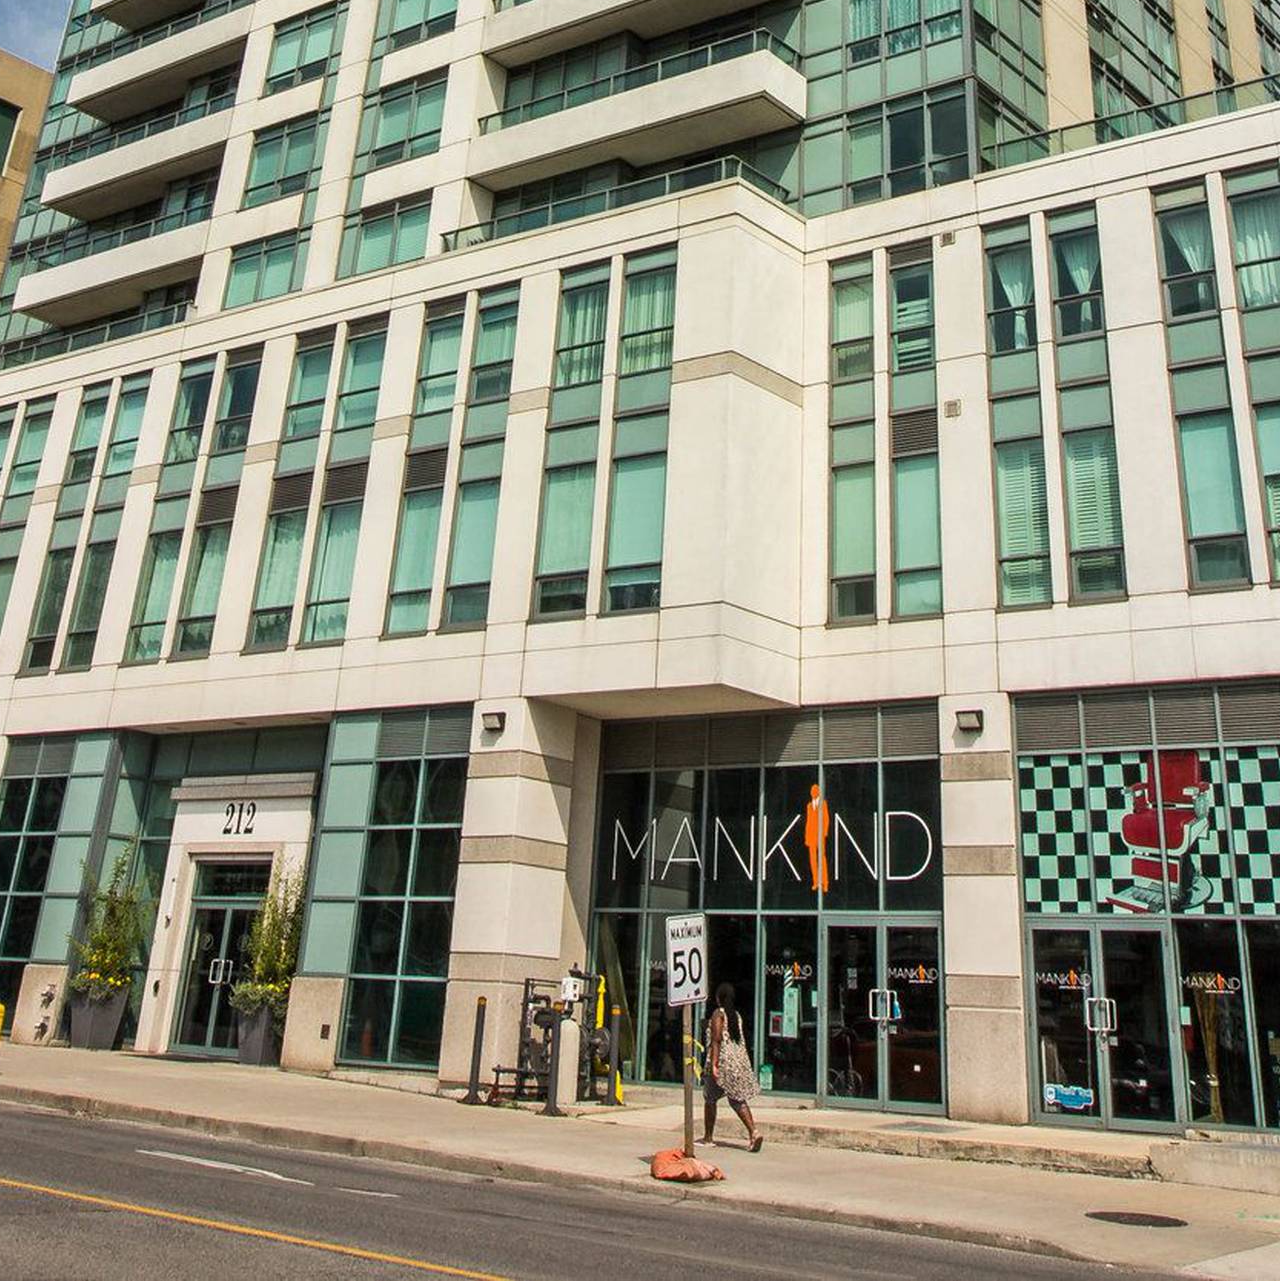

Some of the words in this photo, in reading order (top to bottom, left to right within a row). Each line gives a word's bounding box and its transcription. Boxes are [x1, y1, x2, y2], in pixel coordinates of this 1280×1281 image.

[223, 802, 256, 834] 212
[611, 784, 933, 893] MANKIND
[670, 925, 702, 940] MAXIMUM
[673, 947, 703, 988] 50
[1035, 969, 1092, 987] MANKIND
[1178, 973, 1241, 990] MANKIND
